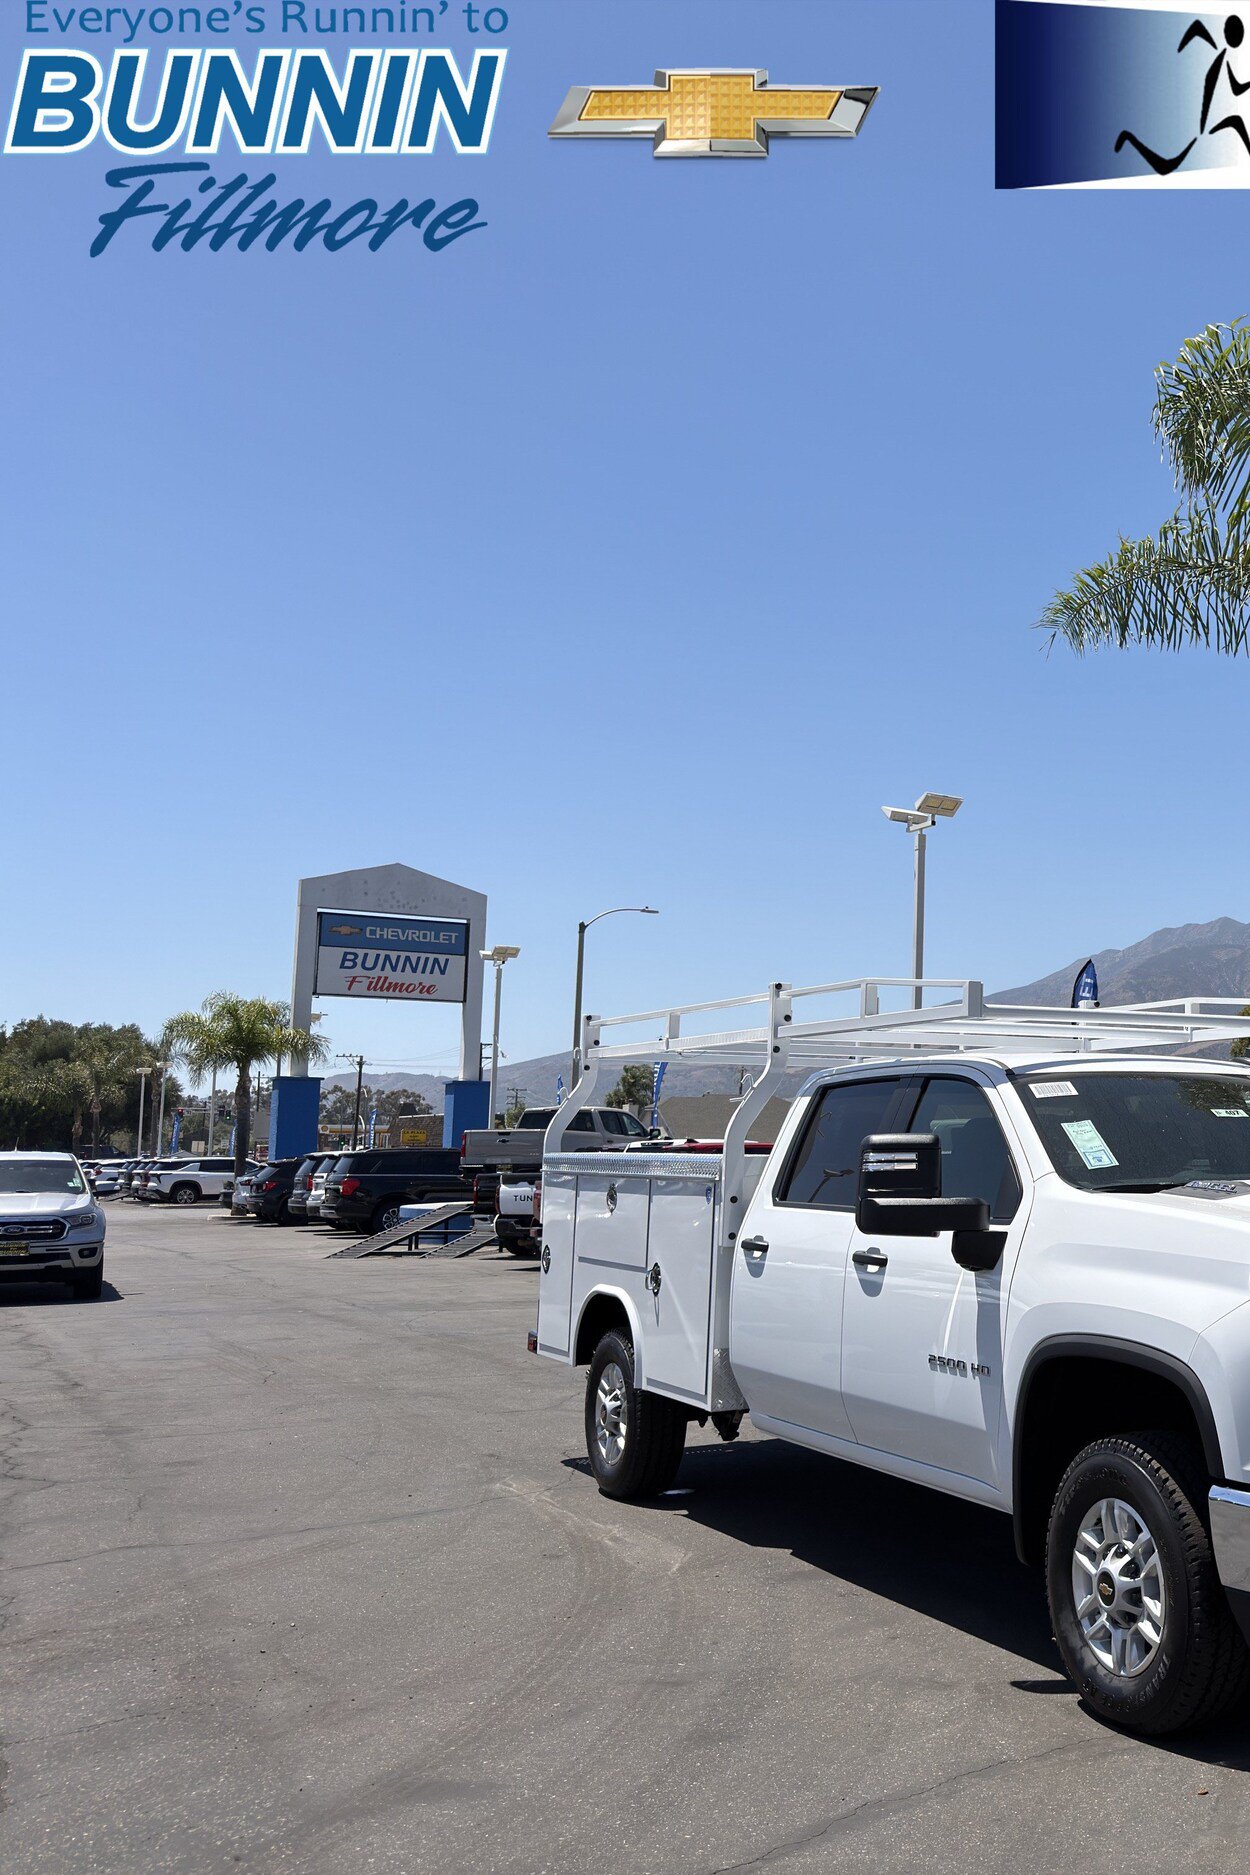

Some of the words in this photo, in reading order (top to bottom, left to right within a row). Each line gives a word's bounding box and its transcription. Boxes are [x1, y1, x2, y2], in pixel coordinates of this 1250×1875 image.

[365, 926, 459, 944] CHEVROLET
[339, 951, 450, 976] BUNNIN
[344, 975, 438, 995] Fillmore
[928, 1354, 966, 1371] 2500
[970, 1363, 991, 1376] HD
